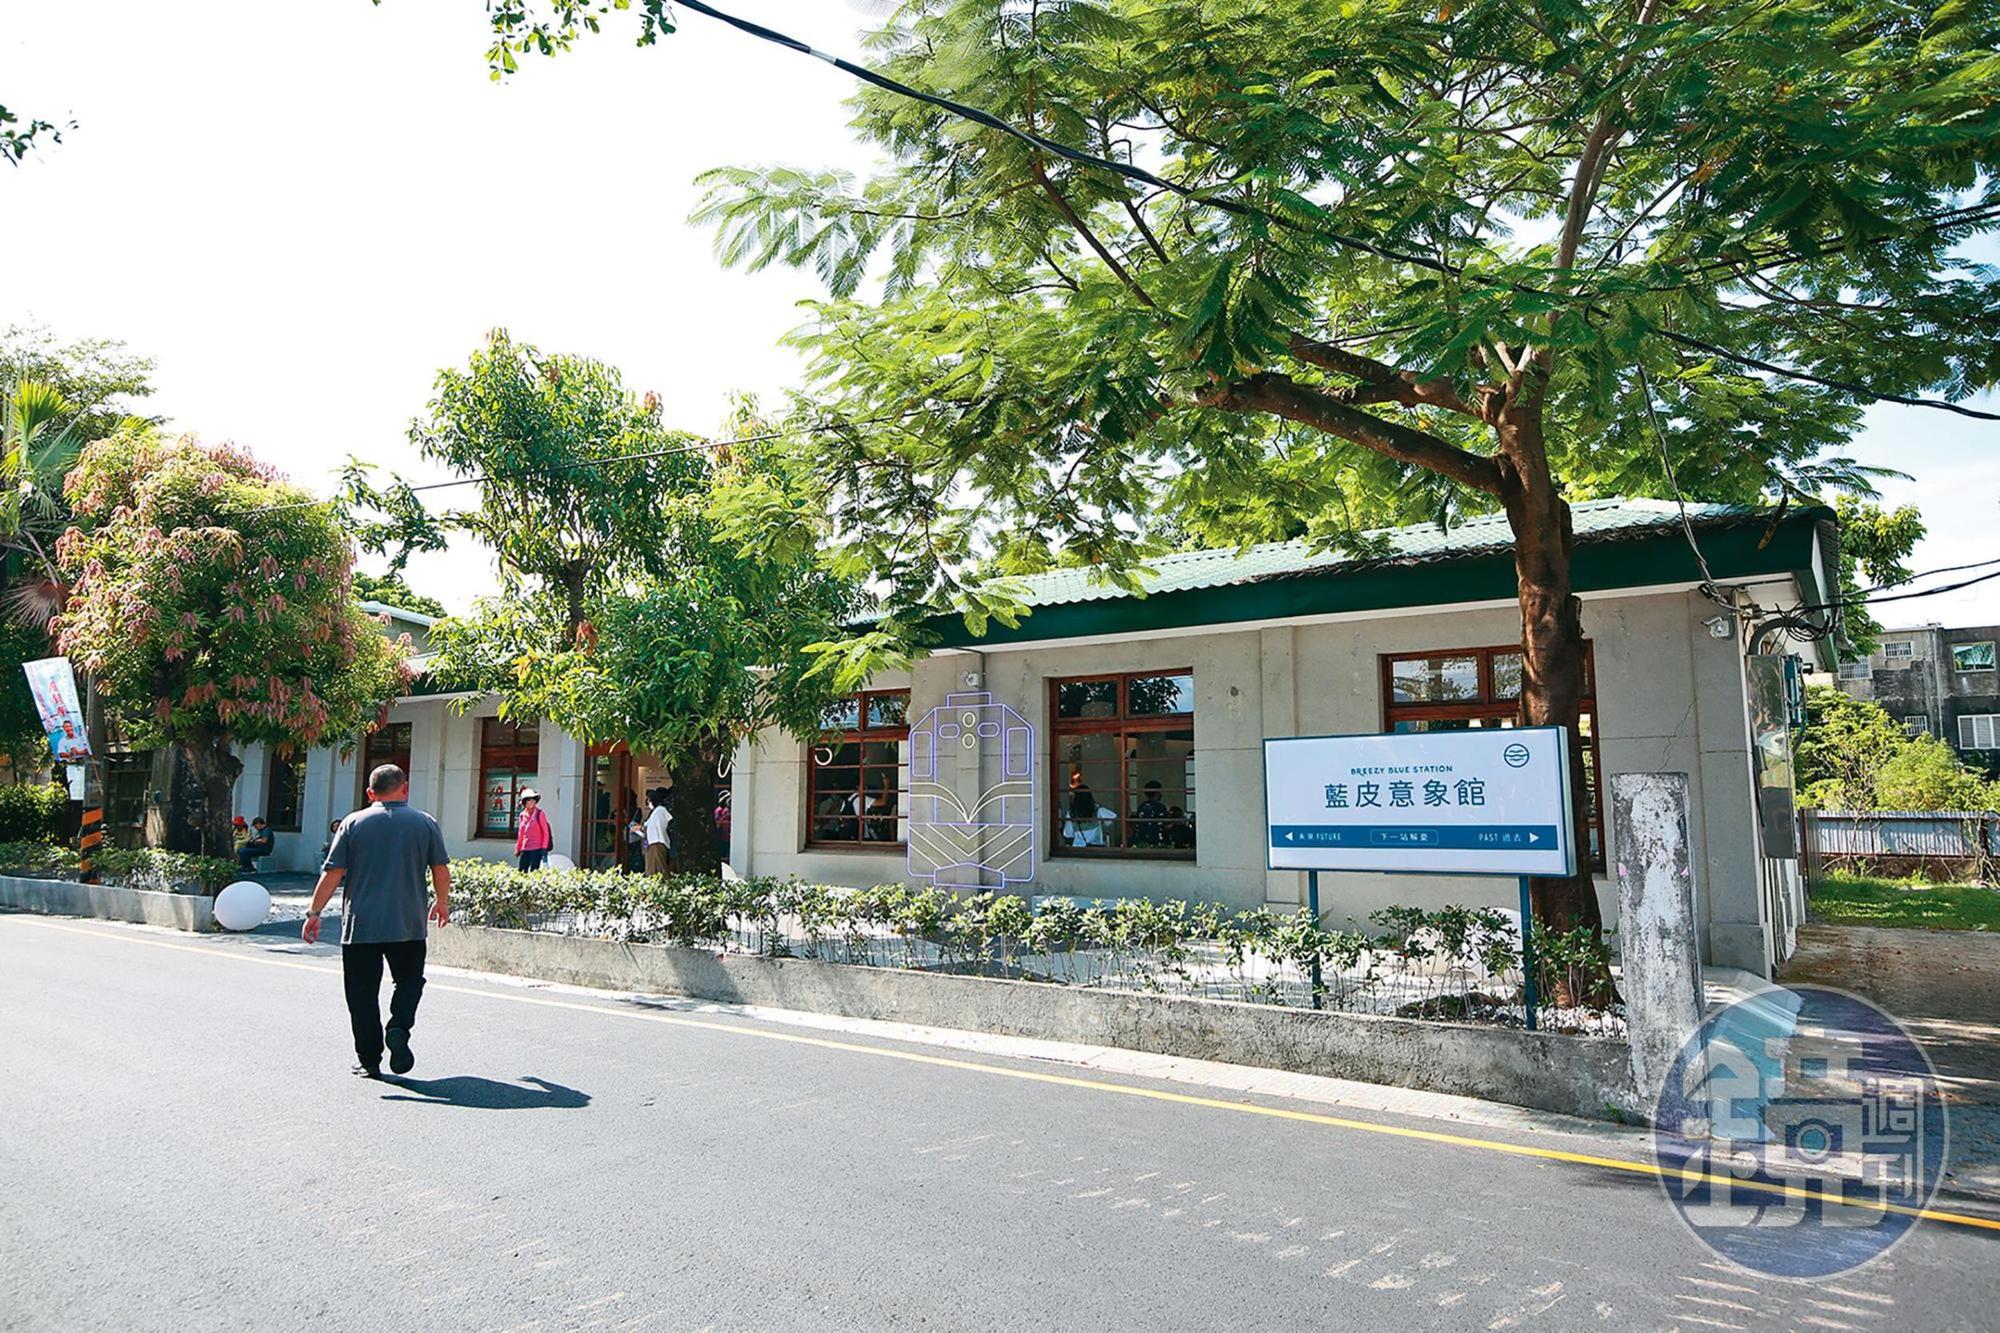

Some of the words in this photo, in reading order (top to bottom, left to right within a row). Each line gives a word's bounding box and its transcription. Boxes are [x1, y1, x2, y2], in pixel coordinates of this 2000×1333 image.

[1350, 766, 1385, 777] BREEZY
[1388, 765, 1410, 774] BLUE
[1413, 764, 1453, 774] STATION
[1324, 777, 1486, 808] 藍皮意象館
[1316, 832, 1341, 841] FUTURE
[1478, 833, 1498, 842] PAST
